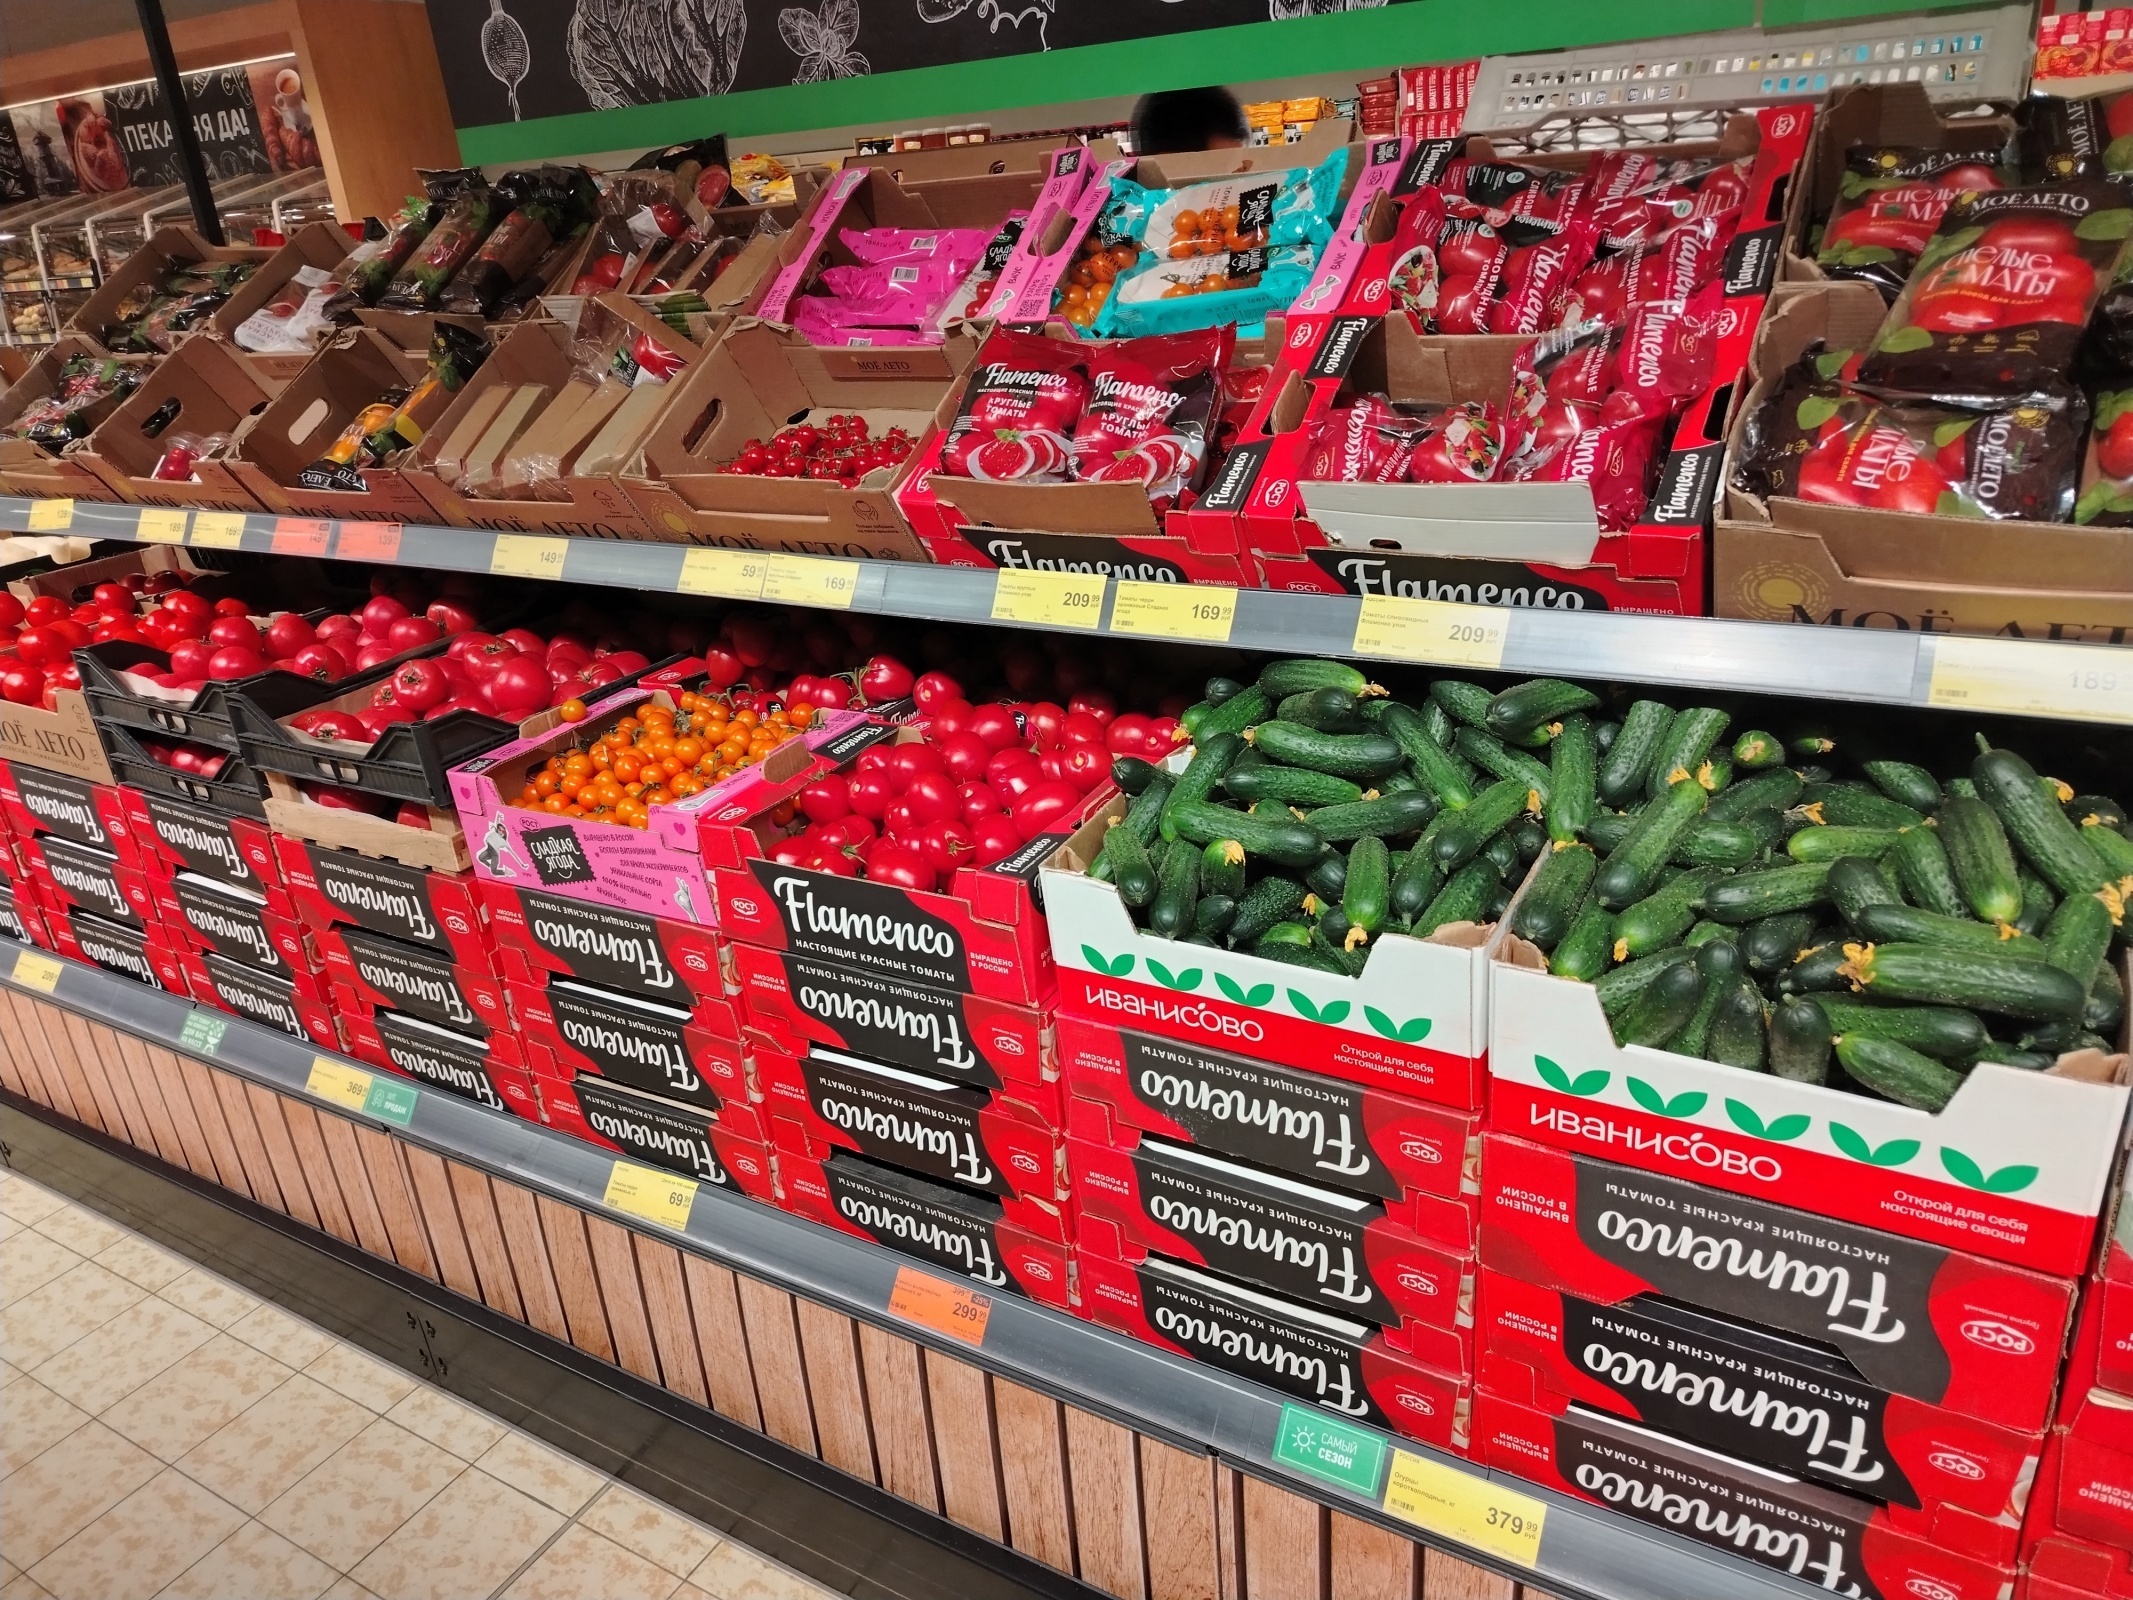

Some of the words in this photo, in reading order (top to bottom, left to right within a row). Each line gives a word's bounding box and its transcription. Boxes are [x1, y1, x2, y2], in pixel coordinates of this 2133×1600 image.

[123, 113, 216, 152] ПЕКАНЯ
[217, 107, 249, 142] ДА!
[1416, 140, 1452, 186] Flamenco
[2025, 193, 2090, 212] ЛЕТО
[1726, 238, 1761, 293] Flamenco
[1926, 265, 2056, 296] ТМАТЫ
[1324, 317, 1367, 374] Flamenco
[885, 361, 910, 372] ЛЕТО
[985, 362, 1068, 388] Flamenco
[985, 405, 1027, 419] ТОМАТЫ
[988, 397, 1032, 410] КРУГЛЫЕ
[1206, 451, 1249, 508] Flamenco
[1265, 479, 1289, 507] РОСТ
[1654, 453, 1700, 523] Flamenco
[539, 551, 557, 564] 149
[741, 565, 756, 578] 59
[988, 539, 1177, 583] Flamenco
[824, 576, 846, 591] 169
[1338, 558, 1585, 609] Flamenco
[1063, 592, 1090, 607] 209
[1091, 594, 1100, 602] 99
[1192, 604, 1220, 620] 169
[1222, 607, 1232, 615] 99
[1613, 605, 1675, 616] ВЫРАЩЕНО
[1221, 614, 1231, 622] руб
[1360, 618, 1389, 629] Фламенко
[1391, 621, 1406, 630] упак
[1362, 610, 1384, 620] Томаты
[1386, 613, 1430, 624] сливовидные
[1448, 624, 1485, 644] 209
[1487, 628, 1499, 638] 99
[2069, 671, 2117, 691] 189
[0, 719, 32, 750] ОЁ
[34, 729, 86, 762] ЛЕТО
[832, 726, 884, 755] Flamenco
[25, 793, 105, 843] Flamenco
[521, 818, 540, 831] РОСТ
[157, 819, 249, 879] Flamenco
[530, 837, 580, 859] СЛАДКАЯ
[995, 837, 1052, 873] Flamenco
[546, 854, 581, 873] ЯГОДА
[51, 864, 130, 916] Flamenco
[602, 876, 619, 888] 100%
[327, 878, 435, 940] Flamenco
[529, 899, 562, 913] ТОМАТЫ
[562, 906, 600, 922] КРАСНЫЕ
[733, 899, 757, 913] РОСТ
[774, 876, 955, 958] Flamenco
[186, 906, 279, 966] Flamenco
[600, 916, 651, 932] НАСТОЯЩИЕ
[535, 919, 674, 988] Flamenco
[795, 938, 857, 960] НАСТОЯЩИЕ
[859, 952, 908, 972] КРАСНЫЕ
[910, 964, 955, 983] ТОМАТЫ
[970, 952, 1014, 968] ВЫРАЩЕНО
[970, 960, 977, 968] В
[977, 962, 1010, 975] РОССИИ
[360, 962, 473, 1025] Flamenco
[800, 986, 976, 1070] Flamenco
[563, 1019, 700, 1092] Flamenco
[1141, 1045, 1194, 1070] ТОМАТЫ
[1333, 1052, 1394, 1076] настоящие
[1396, 1066, 1435, 1085] овощи
[1340, 1043, 1382, 1061] Открой
[1384, 1051, 1405, 1068] для
[1407, 1056, 1435, 1075] себя
[391, 1047, 503, 1112] Flamenco
[1197, 1058, 1258, 1084] КРАСНЫЕ
[346, 1082, 363, 1095] 369
[1262, 1075, 1350, 1108] НАСТОЯЩИЕ
[383, 1102, 407, 1115] ПРОДАЖ
[1141, 1069, 1371, 1176] Flamenco
[590, 1112, 727, 1184] Flamenco
[822, 1098, 993, 1185] Flamenco
[1400, 1141, 1443, 1164] РОСТ
[669, 1192, 684, 1206] 69
[1495, 1193, 1569, 1225] ВЫРАЩЕНО
[1605, 1182, 1676, 1209] ТОМАТЫ
[1683, 1202, 1765, 1236] КРАСНЫЕ
[1880, 1201, 1970, 1233] настоящие
[1972, 1223, 2027, 1246] овощи
[1893, 1189, 1953, 1212] Открой
[1954, 1201, 1985, 1219] для
[1988, 1211, 2029, 1234] себя
[841, 1196, 1007, 1286] Flamenco
[1150, 1195, 1373, 1305] Flamenco
[1771, 1226, 1890, 1265] НАСТОЯЩИЕ
[1598, 1209, 1906, 1343] Flamenco
[952, 1302, 978, 1321] 299
[979, 1311, 987, 1319] 99
[1960, 1319, 2036, 1355] РОСТ
[1155, 1306, 1369, 1417] Flamenco
[1583, 1341, 1886, 1483] Flamenco
[1317, 1447, 1352, 1470] СЕЗОН
[1320, 1432, 1358, 1456] САМЫЙ
[1398, 1452, 1420, 1465] РОССИЯ
[1394, 1470, 1419, 1487] Огурцы
[1485, 1506, 1524, 1535] 379
[1526, 1521, 1538, 1533] 99
[1576, 1463, 1875, 1600] Flamenco
[1523, 1532, 1537, 1541] руб
